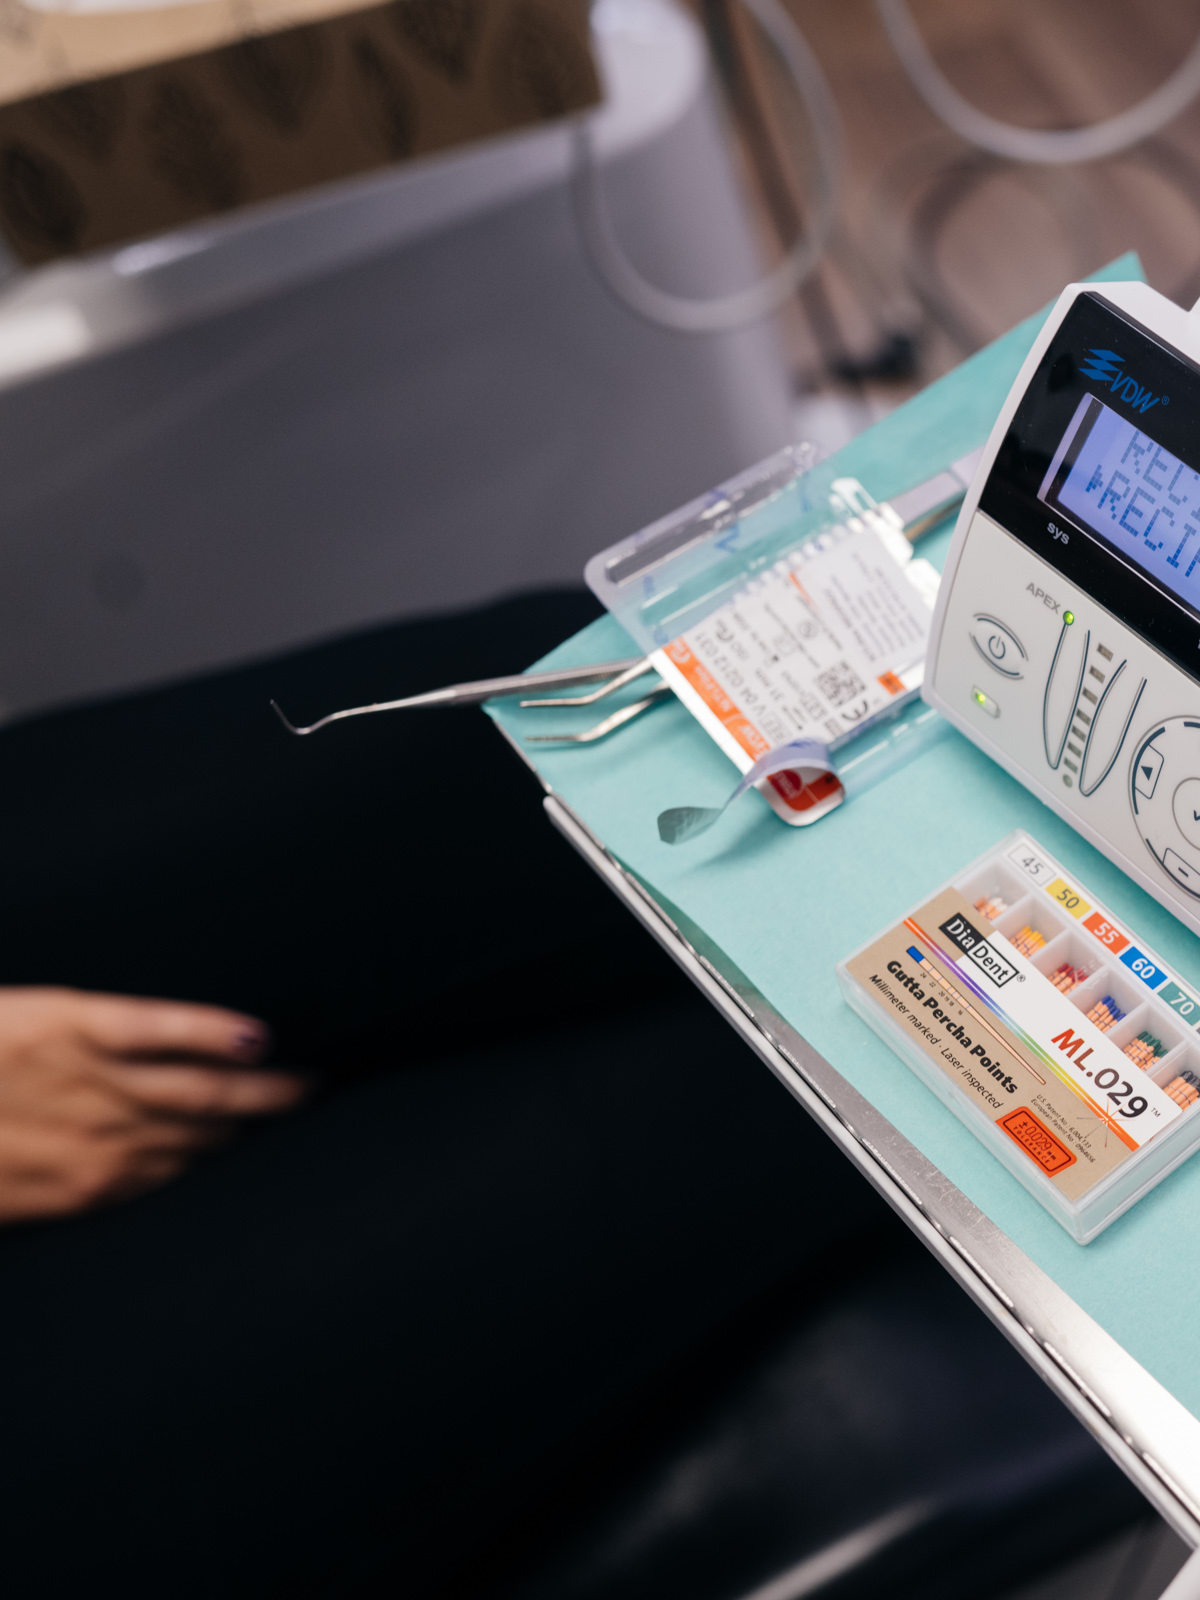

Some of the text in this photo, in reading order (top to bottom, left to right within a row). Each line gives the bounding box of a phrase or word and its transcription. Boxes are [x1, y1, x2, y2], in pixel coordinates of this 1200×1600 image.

[1046, 522, 1070, 545] sys
[1026, 582, 1061, 614] APEX
[1021, 854, 1045, 875] 45
[1056, 888, 1080, 909] 50
[1093, 922, 1120, 945] 55
[1131, 957, 1156, 980] 60
[1168, 991, 1195, 1016] 70
[887, 960, 1018, 1094] Gutta Percha Points
[869, 974, 1004, 1109] Millimeter marked Laser inspected
[1031, 1098, 1053, 1120] European
[1052, 1119, 1068, 1136] Patent
[1036, 1094, 1046, 1103] U.S.
[1045, 1102, 1062, 1119] Patent
[1013, 1126, 1050, 1164] TOLERANCE
